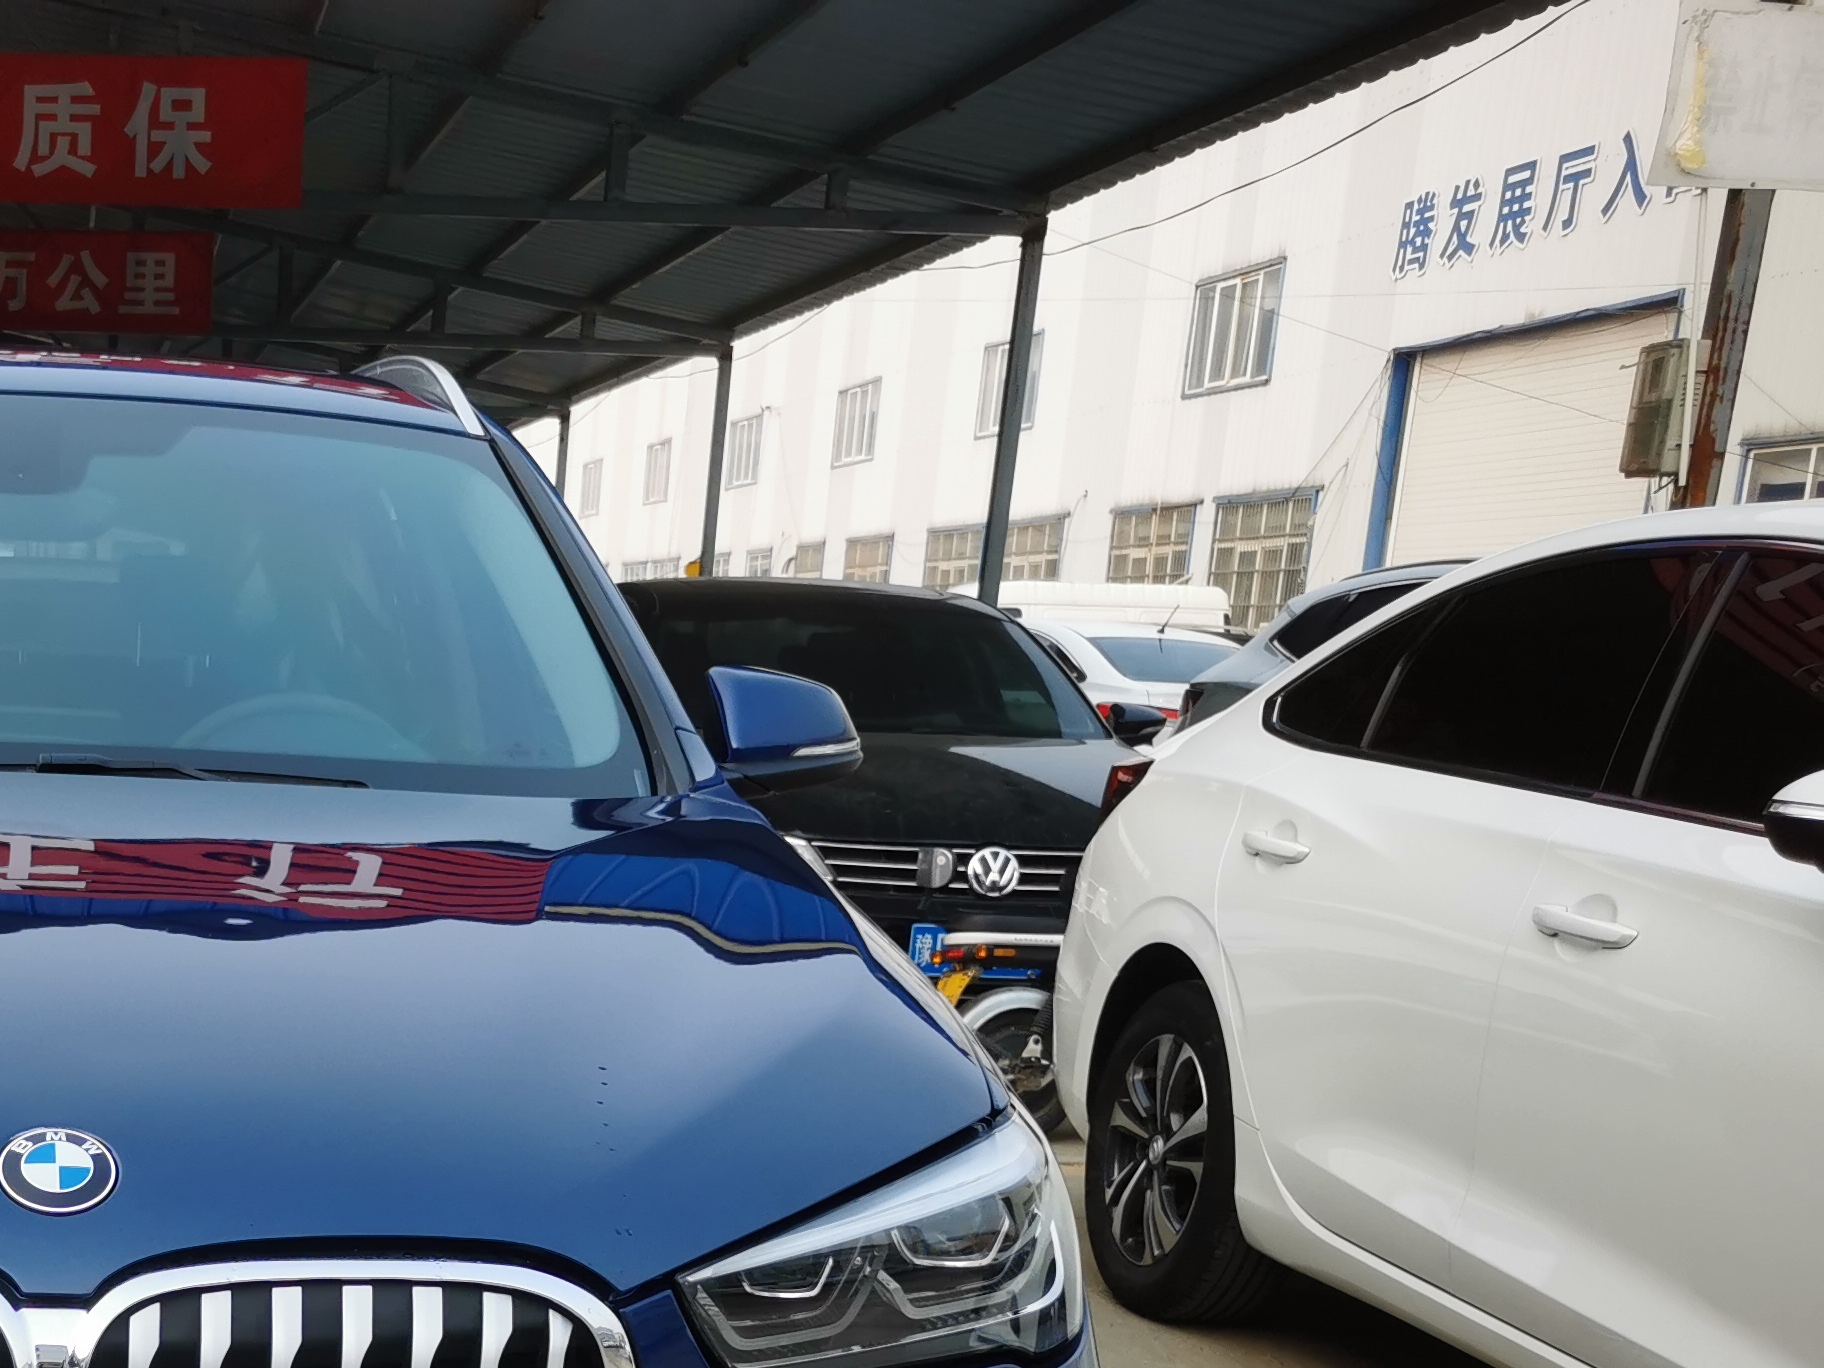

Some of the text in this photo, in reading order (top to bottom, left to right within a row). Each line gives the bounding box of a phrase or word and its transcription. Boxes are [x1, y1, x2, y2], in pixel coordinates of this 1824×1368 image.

[1391, 128, 1700, 279] 腾发展厅入
[10, 1130, 104, 1155] BMW
